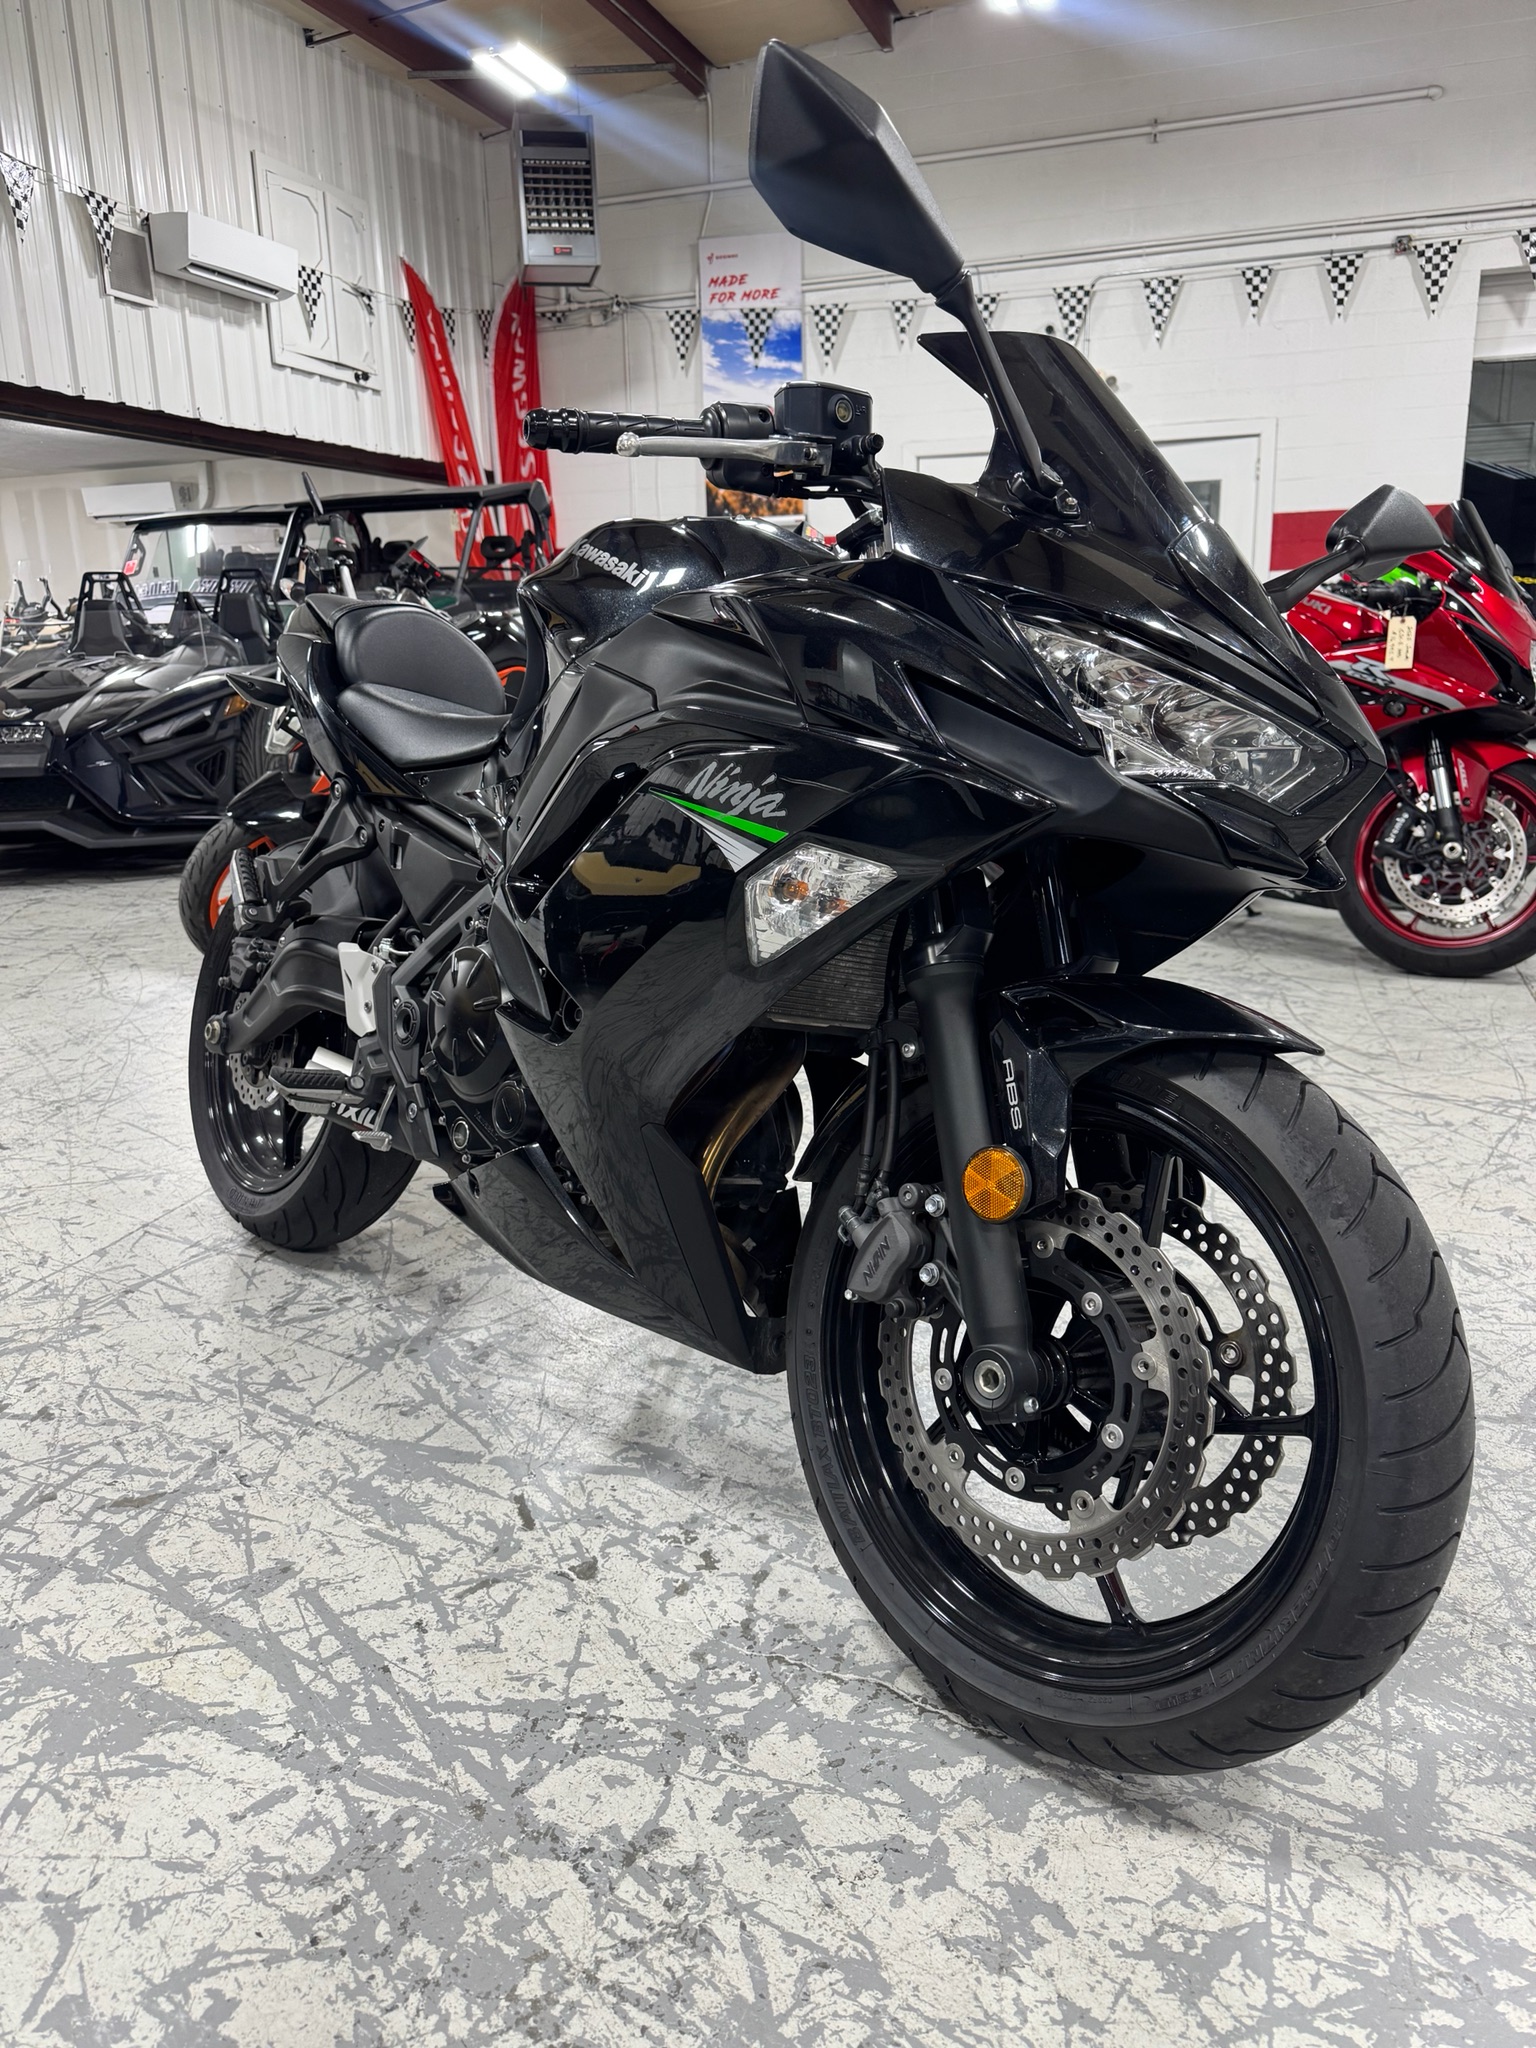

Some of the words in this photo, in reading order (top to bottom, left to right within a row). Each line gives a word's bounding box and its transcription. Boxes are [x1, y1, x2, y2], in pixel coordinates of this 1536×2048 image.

[708, 273, 749, 288] MADE
[709, 291, 737, 304] FOR
[741, 287, 781, 301] MORE
[568, 538, 650, 588] Kawasaki
[1302, 596, 1332, 615] UKI
[684, 761, 786, 818] Ninja
[1002, 1058, 1022, 1130] ABS
[803, 1353, 826, 1441] BT023
